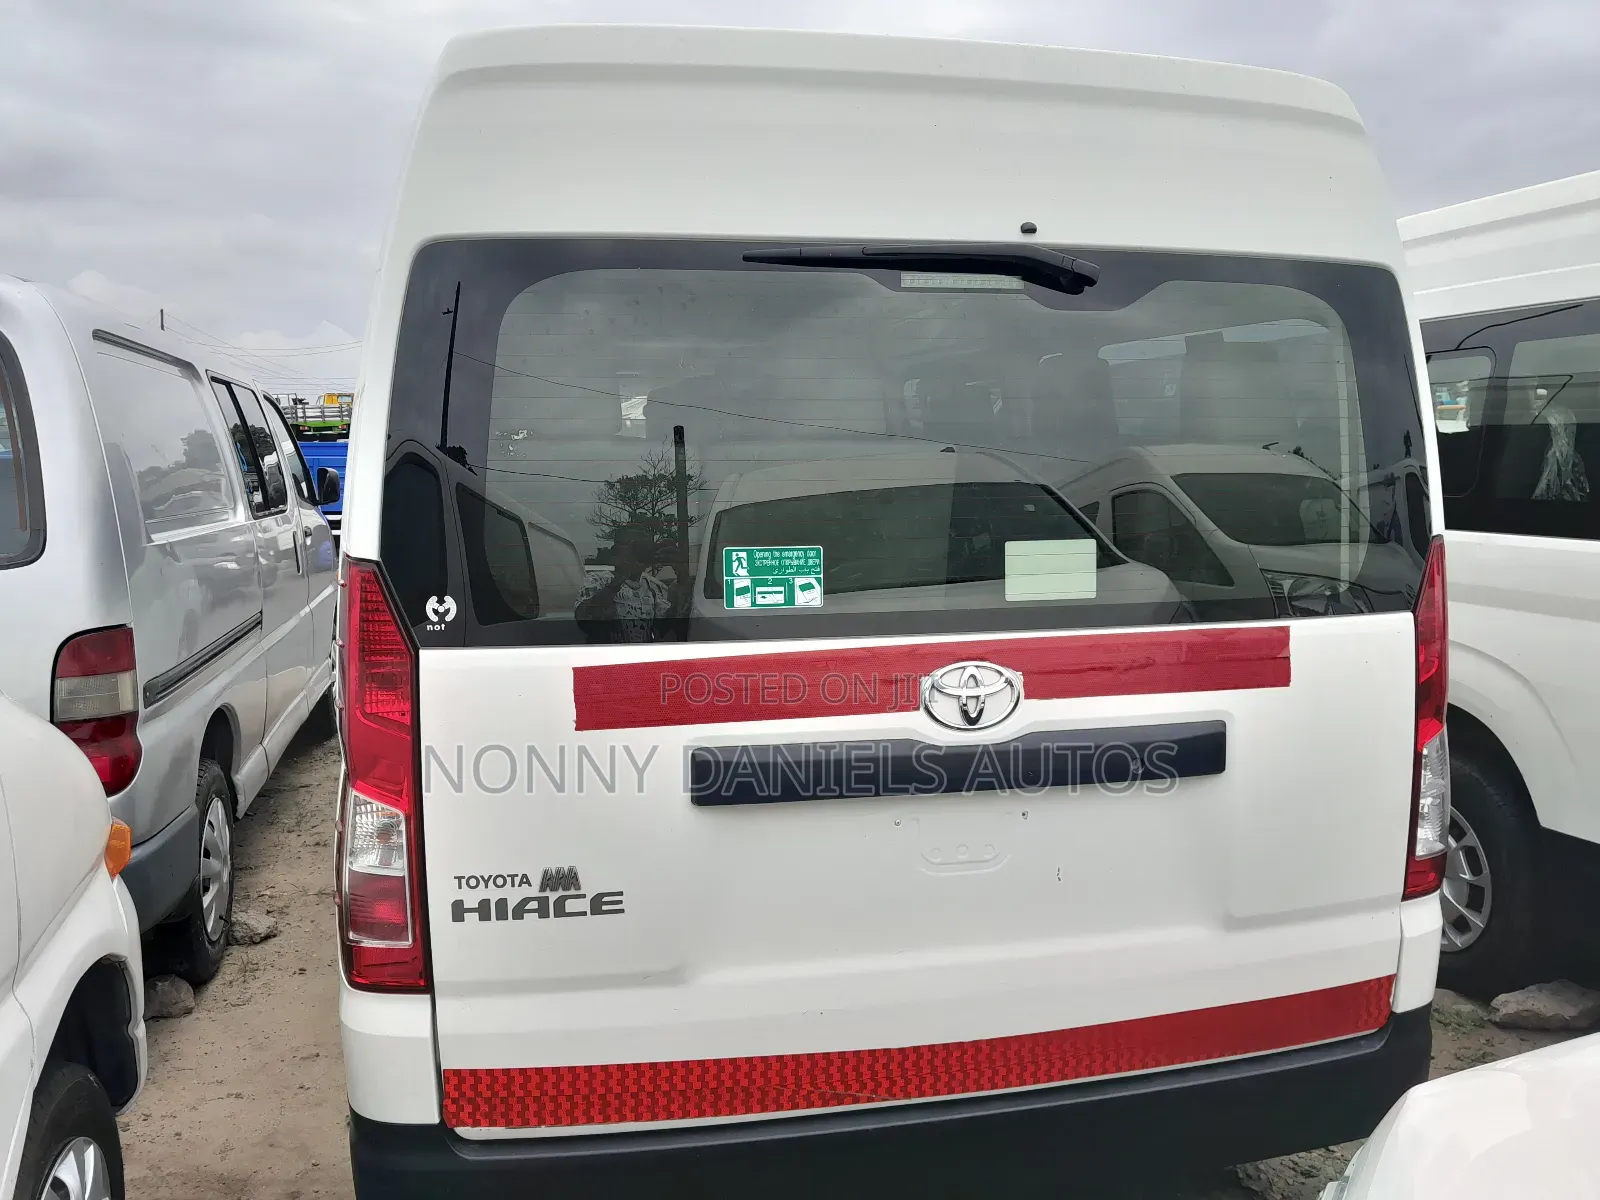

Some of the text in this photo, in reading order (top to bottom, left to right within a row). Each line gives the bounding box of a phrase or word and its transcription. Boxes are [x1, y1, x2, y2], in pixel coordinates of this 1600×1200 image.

[754, 550, 771, 560] Opening
[807, 550, 816, 558] door
[453, 873, 532, 890] TOYOTA
[450, 890, 626, 923] HIACE
